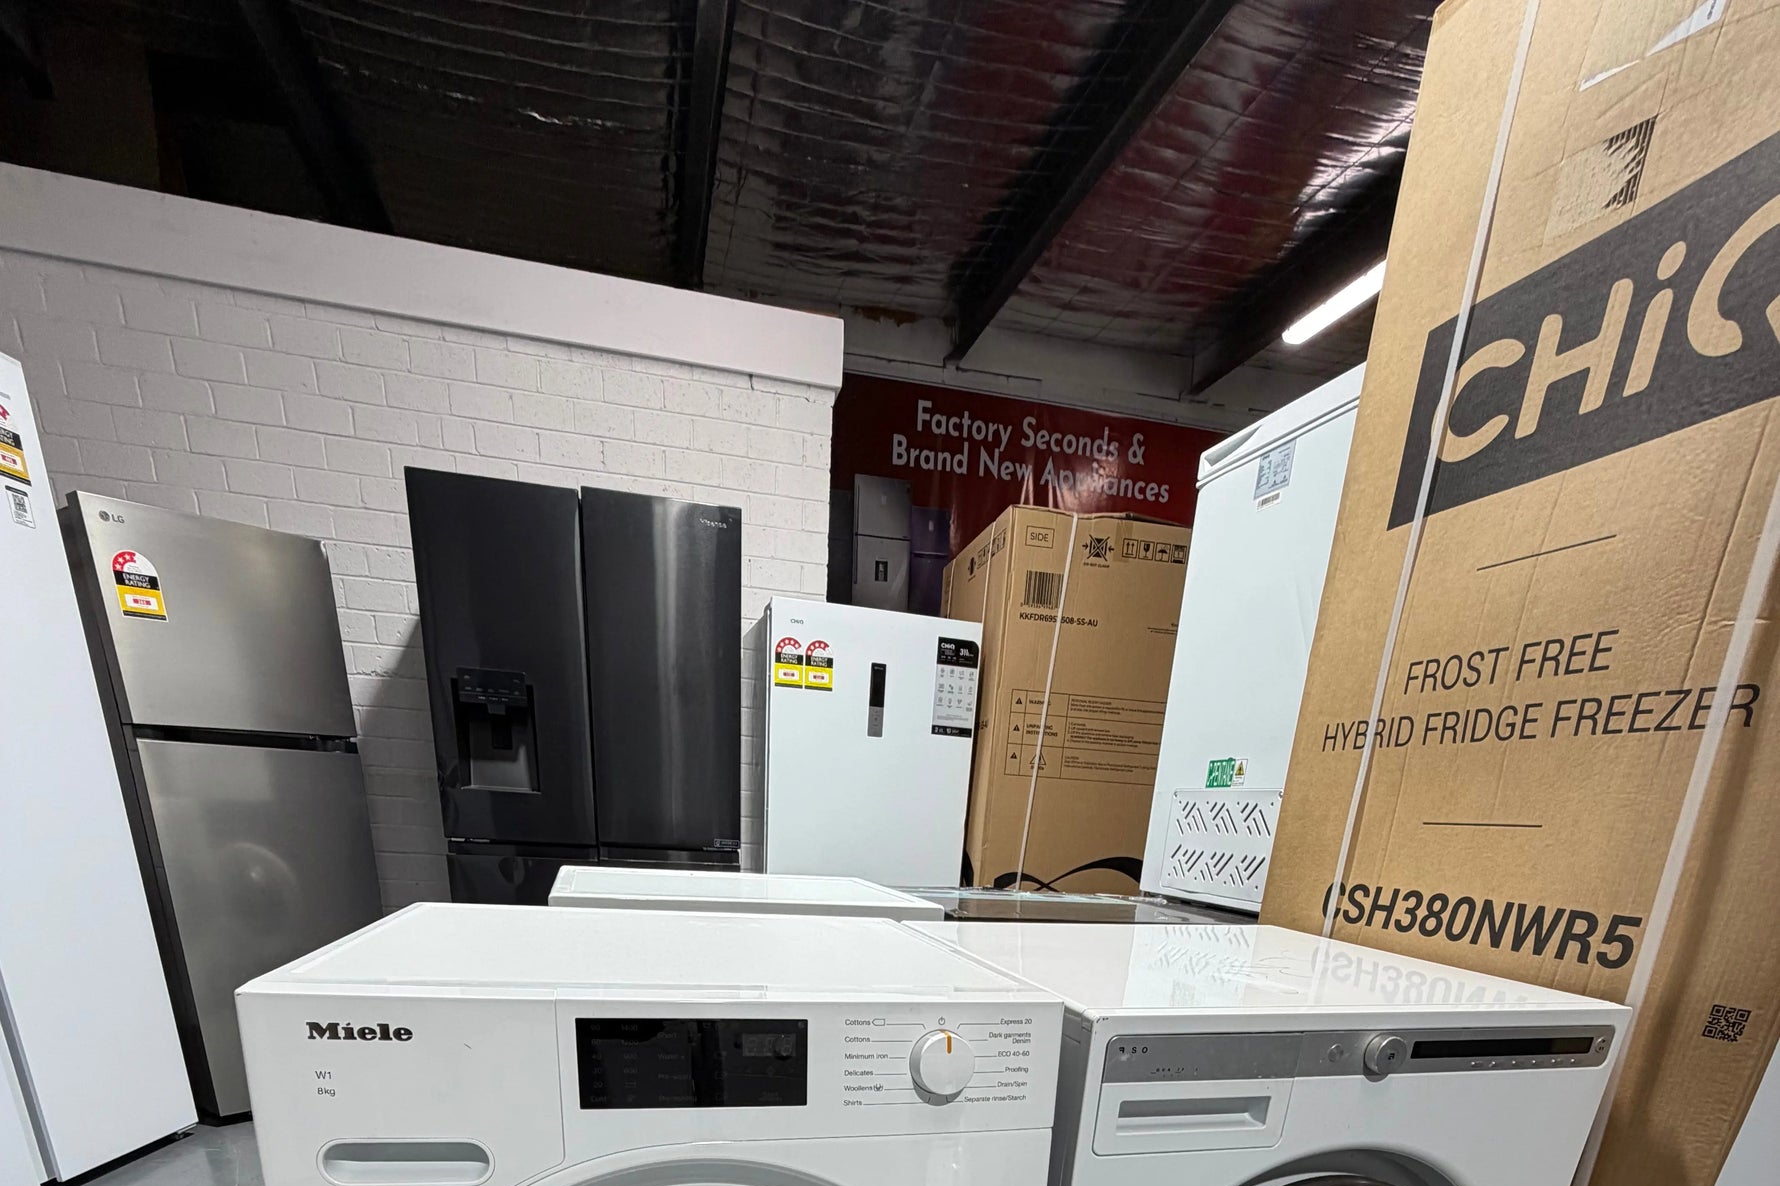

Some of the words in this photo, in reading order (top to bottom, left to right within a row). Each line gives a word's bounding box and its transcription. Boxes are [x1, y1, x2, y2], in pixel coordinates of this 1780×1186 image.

[916, 399, 1012, 451] Factory
[1021, 416, 1118, 463] Seconds
[1127, 432, 1146, 466] &
[892, 433, 968, 475] Brand
[979, 446, 1032, 482] New
[1040, 456, 1169, 503] Appliances
[1030, 532, 1049, 543] SIDE
[122, 573, 149, 582] ENERGY
[124, 579, 151, 588] RATING
[1404, 646, 1509, 695] FROST
[1515, 629, 1620, 682] FREE
[1322, 715, 1414, 752] HYBRID
[1422, 703, 1542, 746] FRIDGE
[1550, 683, 1761, 738] FREEZER
[1321, 881, 1643, 969] CSH380NWR5
[1000, 1018, 1023, 1026] Express
[305, 1022, 413, 1041] Miele
[998, 1050, 1011, 1058] ECO
[315, 1070, 332, 1080] W1
[844, 1069, 874, 1077] Delicates
[317, 1087, 336, 1097] 8kg
